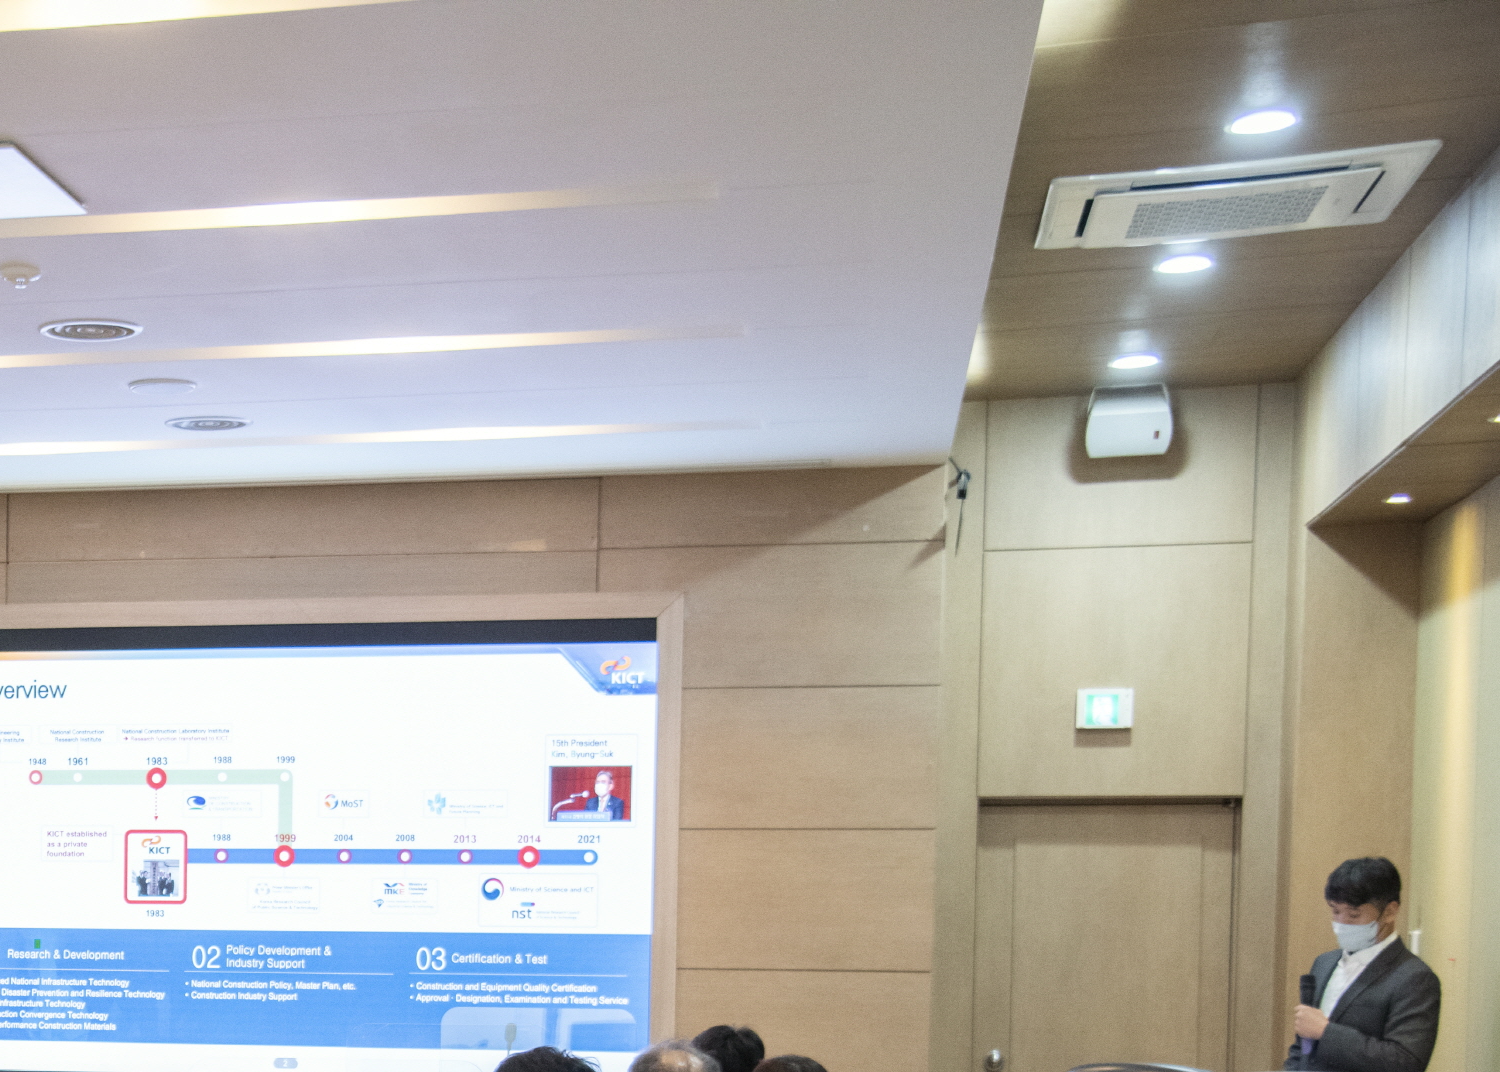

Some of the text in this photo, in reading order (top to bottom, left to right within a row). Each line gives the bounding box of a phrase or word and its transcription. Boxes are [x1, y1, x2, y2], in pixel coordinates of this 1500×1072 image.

[611, 672, 645, 685] KICT
[551, 739, 608, 747] 15th President
[213, 756, 233, 764] 1988
[275, 755, 296, 764] 1999
[551, 751, 614, 759] Kim, Byung-Suk
[67, 757, 89, 766] 1961
[146, 756, 168, 766] 1983
[340, 799, 364, 808] MoST
[46, 830, 108, 838] KICT established
[212, 834, 231, 842] 1988
[274, 834, 297, 843] 1999
[333, 834, 354, 842] 2004
[395, 834, 415, 842] 2008
[453, 834, 477, 844] 2013
[517, 834, 541, 844] 2014
[577, 834, 601, 844] 2021
[63, 840, 88, 850] private
[46, 850, 85, 858] foundation
[149, 846, 171, 855] KICT
[146, 909, 165, 918] 1983
[511, 908, 533, 920] nst
[7, 948, 125, 961] Research & Development
[226, 944, 332, 957] Policy Development &
[191, 945, 221, 969] 02
[416, 946, 447, 971] 03
[451, 952, 548, 965] Certification & Test
[226, 957, 306, 970] Industry Support
[10, 977, 40, 986] National
[41, 977, 87, 986] Infrastructure
[88, 978, 130, 988] Technology
[191, 979, 357, 991] National Construction Policy, Master Plan, etc.
[416, 982, 597, 993] Construction and Equipment Quality Certification
[1, 988, 30, 997] Disaster
[31, 988, 70, 997] Prevention
[70, 989, 84, 998] and
[85, 989, 122, 998] Resilience
[123, 990, 165, 1000] Technology
[190, 991, 298, 1002] Construction Industry Support
[44, 999, 86, 1009] Technology
[416, 993, 629, 1006] Approval Designation, Examination and Testing Service
[19, 1010, 66, 1020] Convergence
[67, 1011, 109, 1021] Technology
[38, 1021, 83, 1030] Construction
[83, 1022, 117, 1031] Materials
[282, 1059, 289, 1067] 2
